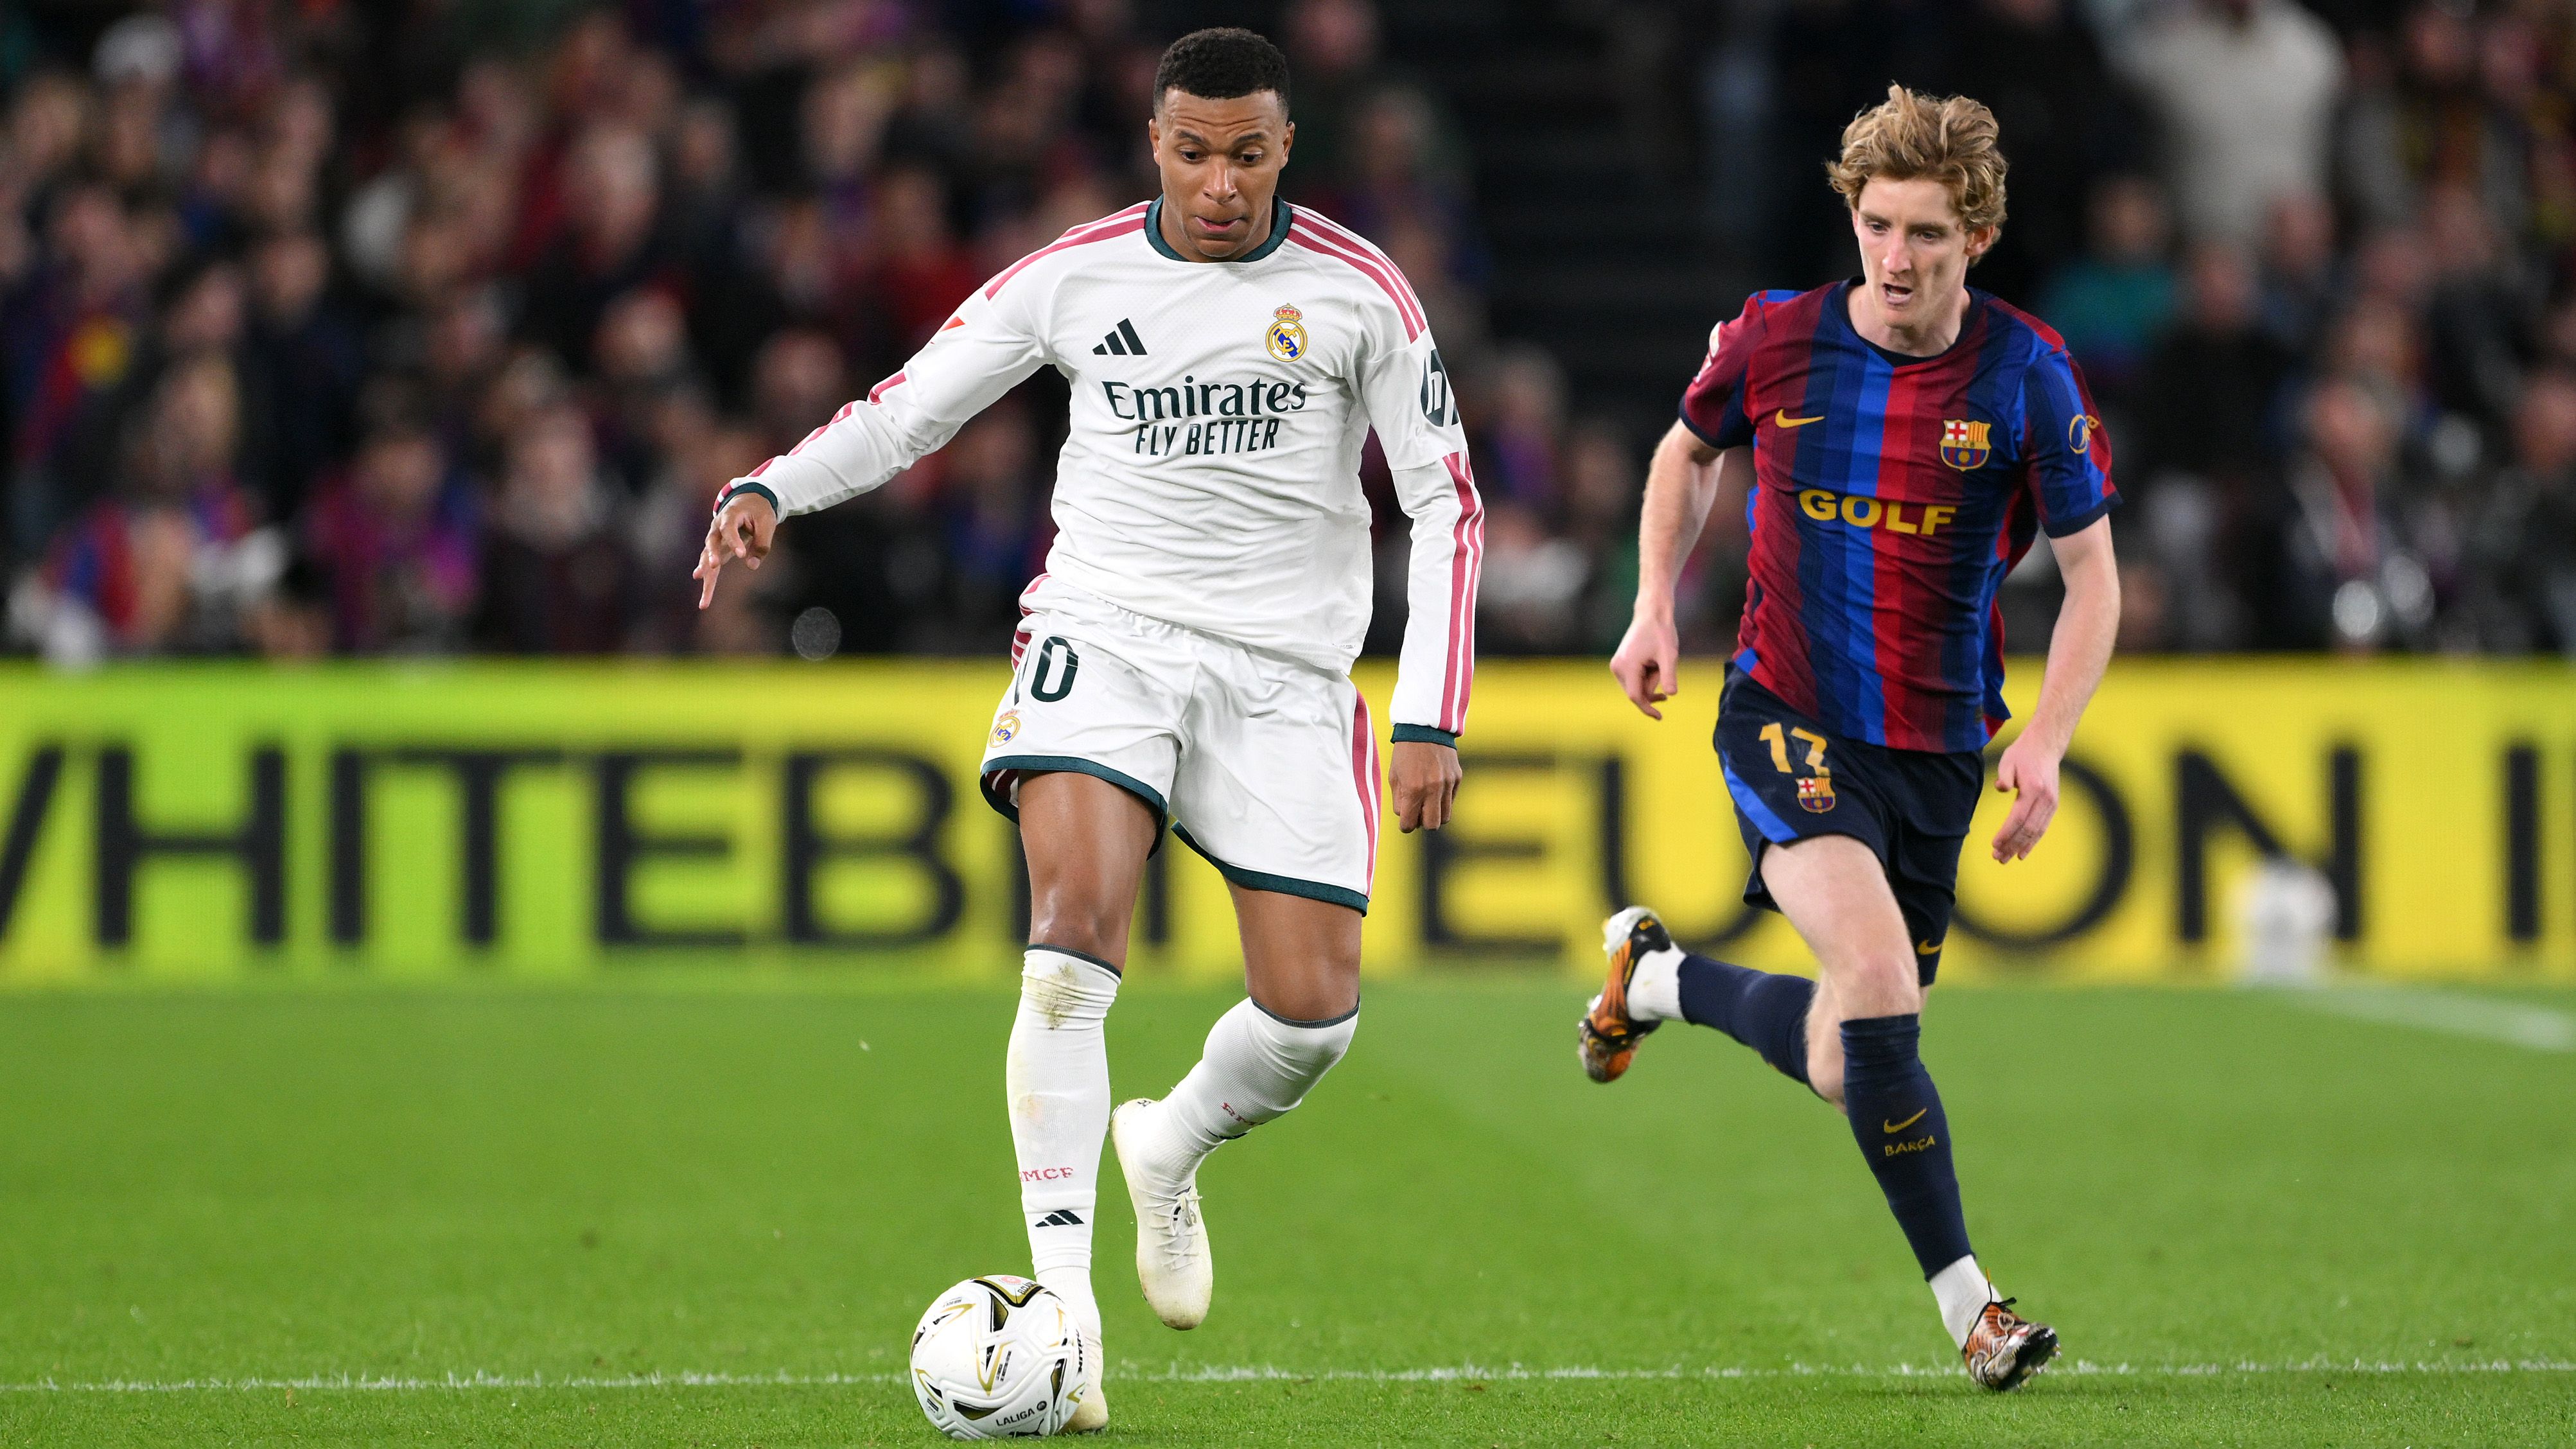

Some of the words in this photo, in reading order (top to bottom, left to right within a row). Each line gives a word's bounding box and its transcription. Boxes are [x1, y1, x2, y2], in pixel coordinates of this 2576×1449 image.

[1101, 375, 1307, 421] Emirates
[1135, 424, 1178, 457] FLY
[1185, 418, 1280, 455] BETTER
[1799, 489, 1957, 536] GOLF
[1014, 636, 1079, 707] 0
[0, 742, 1173, 949] HITEB
[1884, 1135, 1936, 1156] BARÇA
[995, 1408, 1035, 1427] LALIGA
